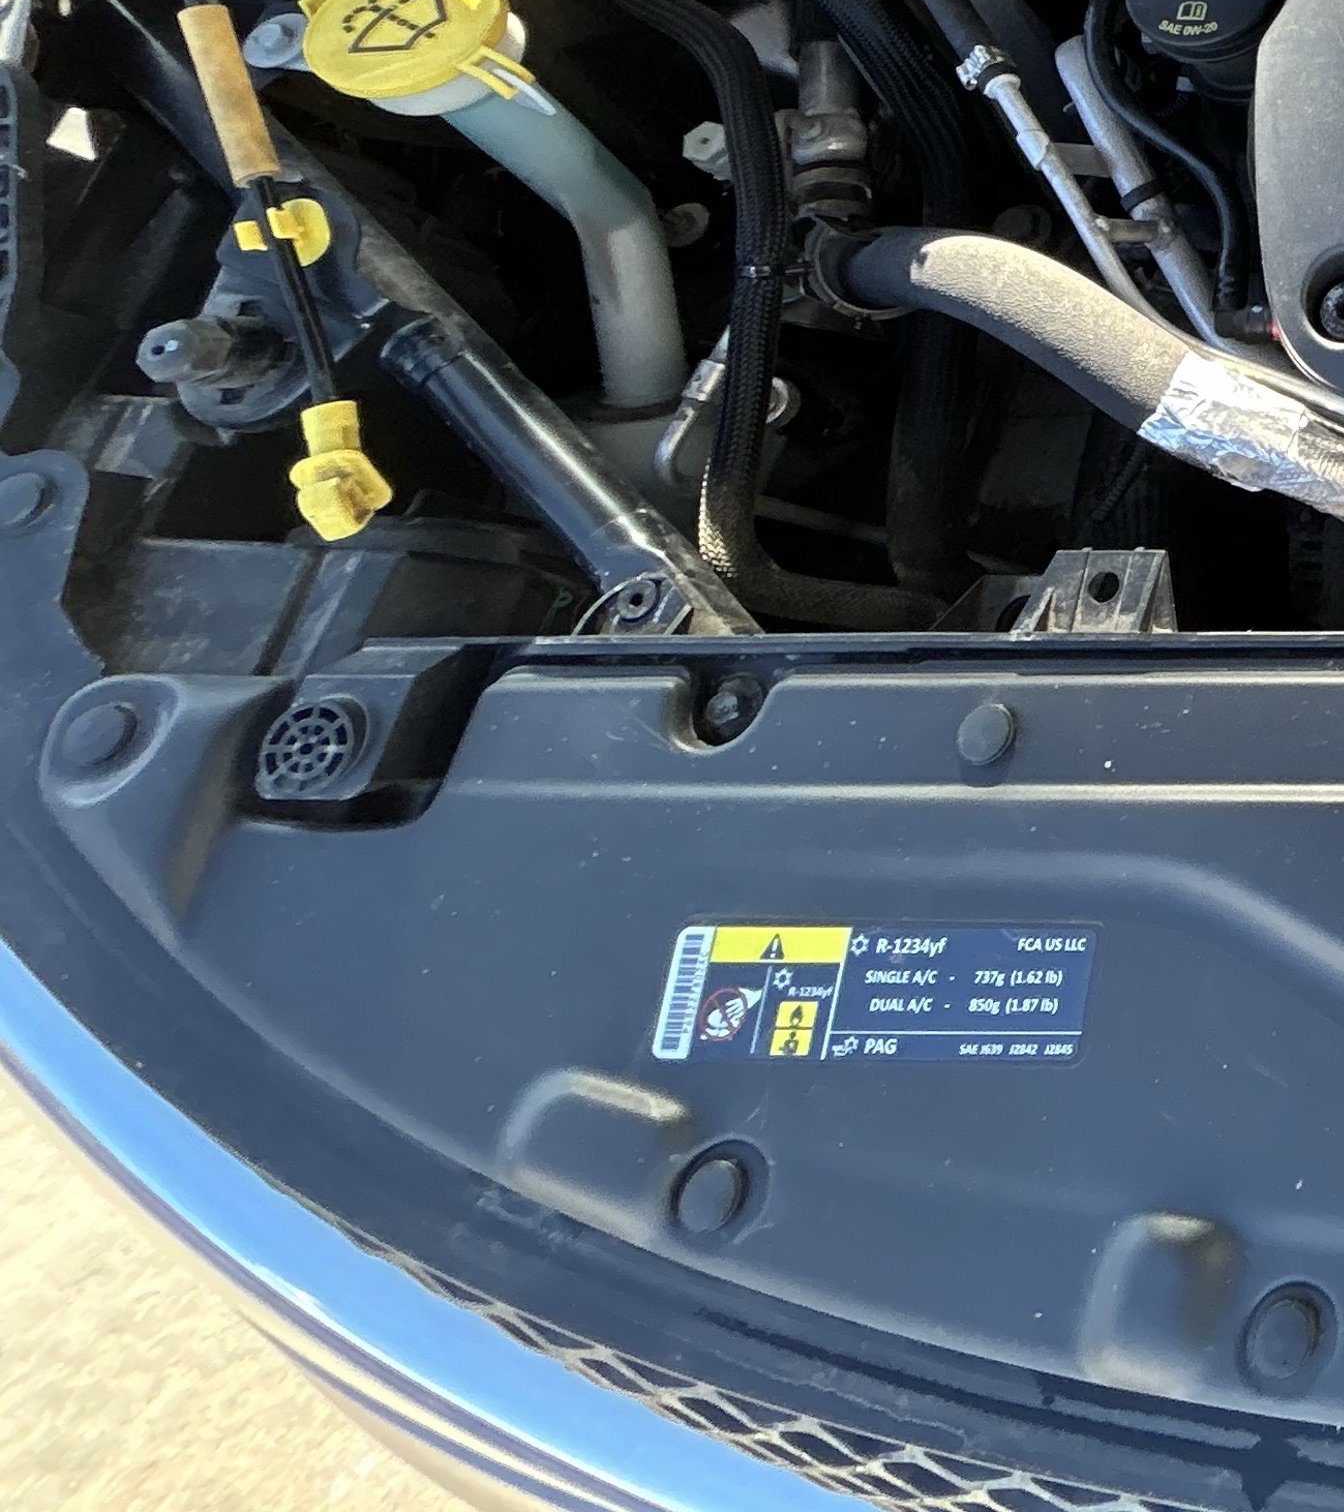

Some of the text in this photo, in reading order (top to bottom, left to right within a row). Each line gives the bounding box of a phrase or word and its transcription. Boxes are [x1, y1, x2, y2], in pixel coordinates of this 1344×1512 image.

[1158, 20, 1219, 36] SAE 0W-20
[876, 937, 948, 958] R-1234yf
[1017, 937, 1087, 952] FCA US LLC
[864, 969, 911, 984] SINGLE
[911, 968, 938, 986] A/C
[974, 970, 1006, 987] 737g
[1010, 969, 1043, 987] (1.62
[1045, 969, 1063, 987] lb)
[788, 986, 833, 999] R-1234yf
[869, 998, 905, 1013] DUAL
[906, 996, 934, 1014] A/C
[968, 997, 1001, 1015] 850g
[1005, 997, 1039, 1015] (1.87
[1040, 997, 1059, 1015] lb)
[863, 1037, 898, 1055] PAG
[959, 1043, 979, 1056] SAE
[980, 1043, 1004, 1056] J639
